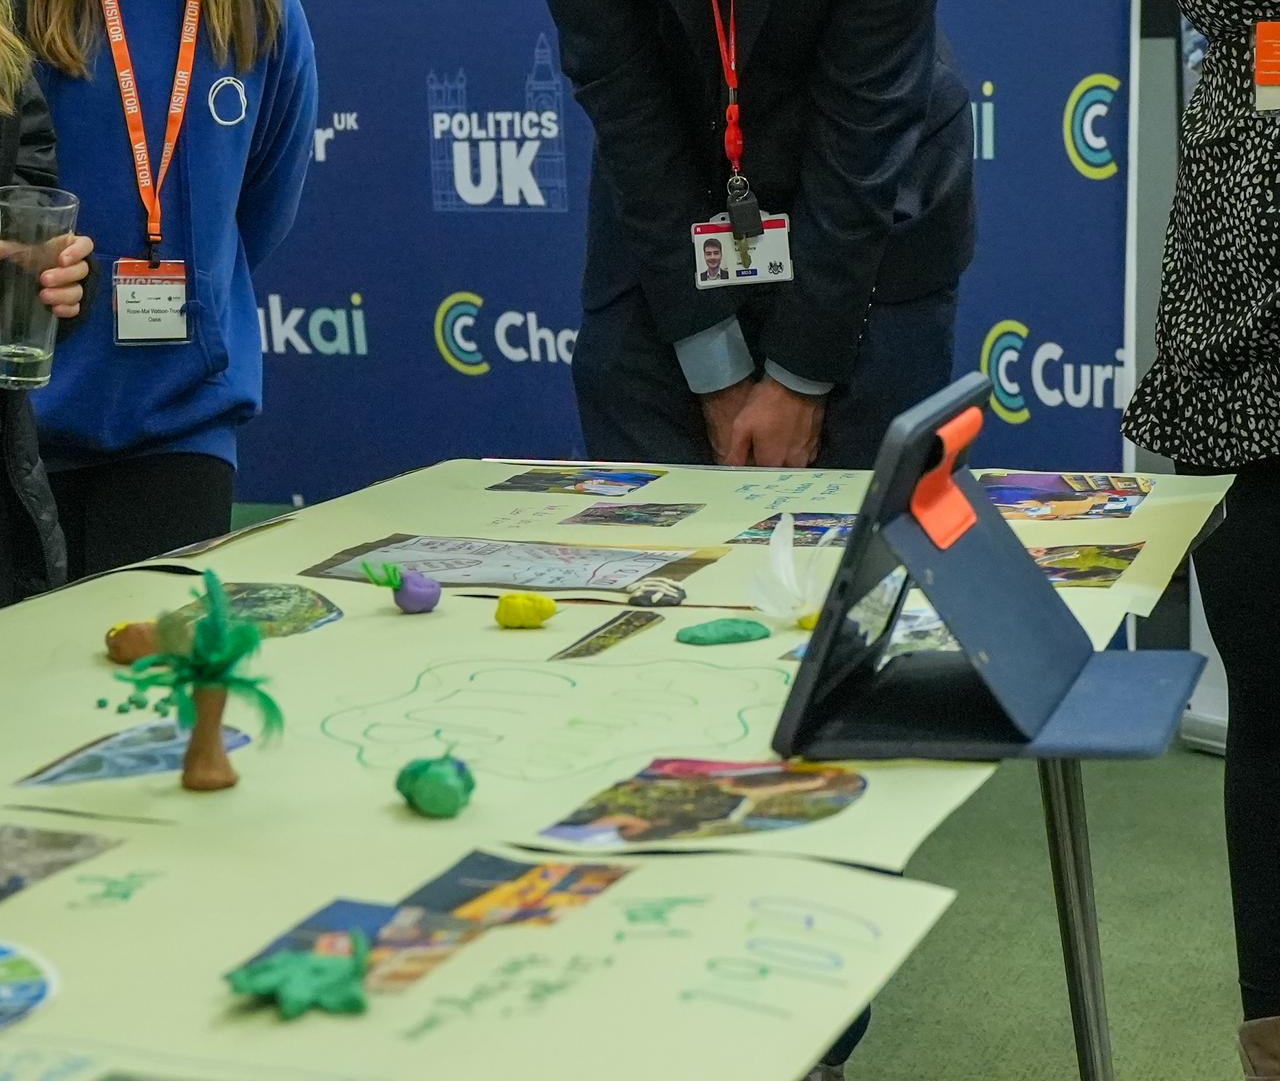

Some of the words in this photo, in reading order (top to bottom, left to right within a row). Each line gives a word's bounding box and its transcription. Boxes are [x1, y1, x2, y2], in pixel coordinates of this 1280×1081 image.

[182, 0, 200, 43] VISITOR
[119, 69, 138, 114] VISITOR
[171, 70, 189, 114] VISITOR
[433, 111, 559, 139] POLITICS
[133, 141, 151, 187] VISITOR
[452, 140, 546, 207] UK
[257, 292, 368, 355] kai
